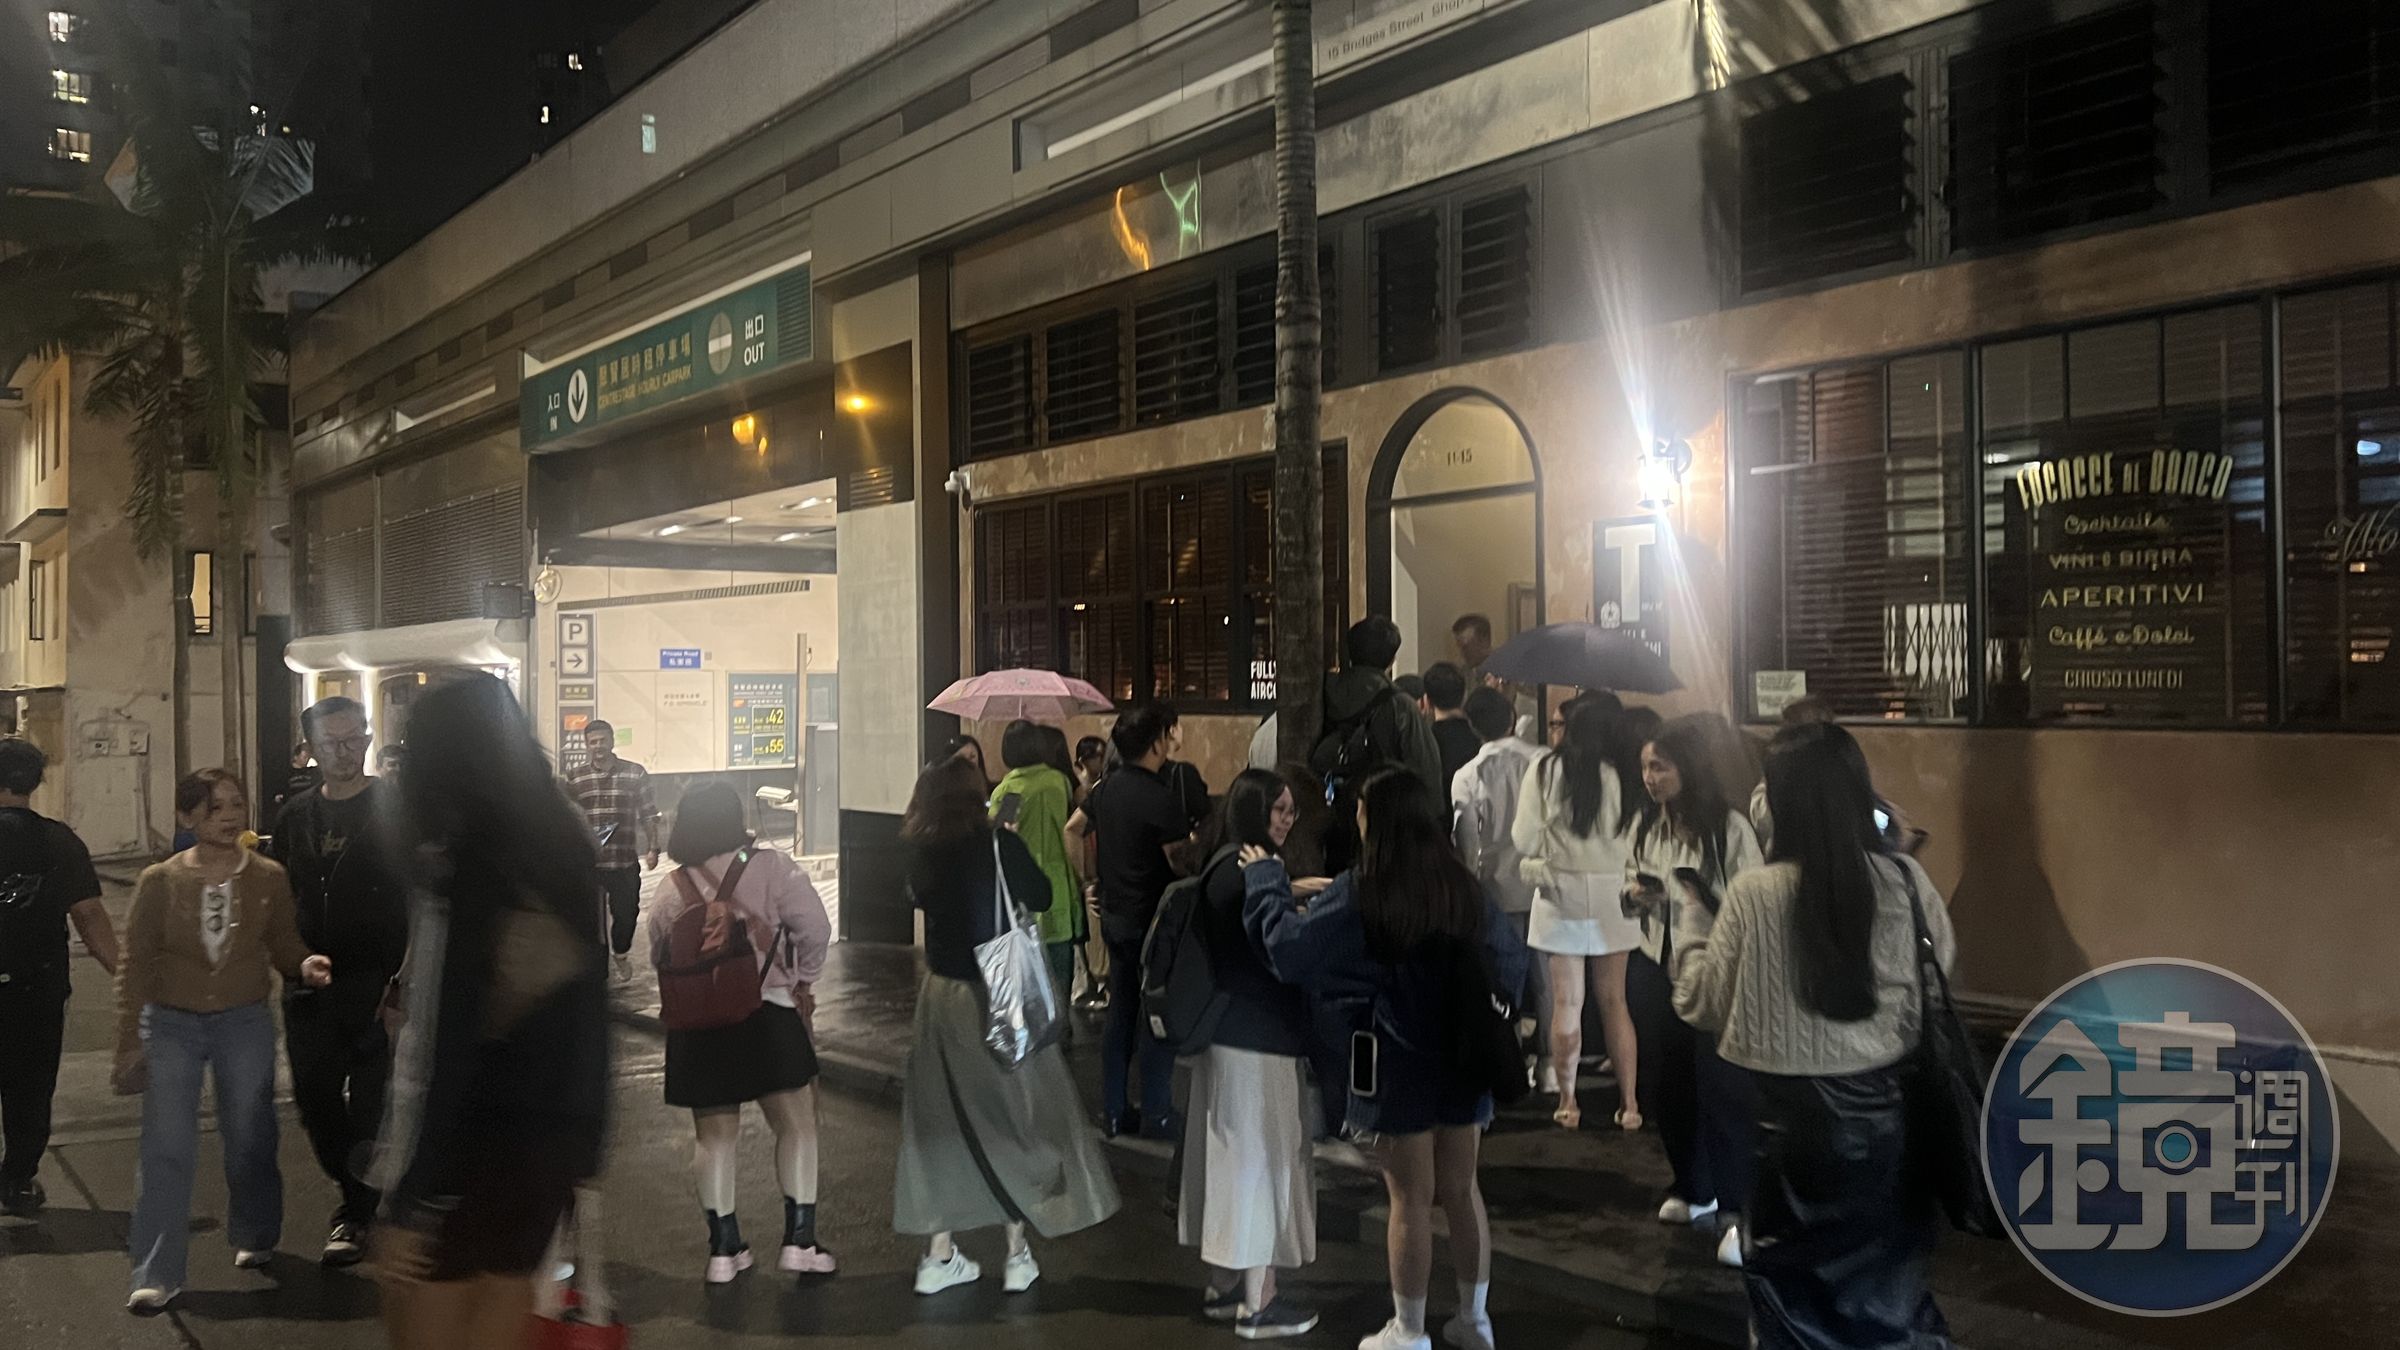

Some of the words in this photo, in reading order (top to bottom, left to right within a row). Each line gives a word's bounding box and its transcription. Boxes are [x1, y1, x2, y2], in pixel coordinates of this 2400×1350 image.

[1343, 28, 1386, 54] Bridges
[1389, 11, 1424, 35] Street
[745, 313, 764, 340] 出口
[744, 341, 765, 366] OUT
[662, 364, 691, 386] CARPARK
[547, 392, 560, 413] 入口
[550, 415, 558, 432] IN
[2016, 451, 2113, 511] FOCACCE
[2149, 448, 2234, 500] BANCO
[2048, 552, 2095, 570] VINI
[2119, 547, 2193, 569] BIRRA
[1605, 523, 1656, 623] T
[2040, 583, 2204, 608] APERITIVI
[568, 623, 583, 641] P
[2132, 624, 2195, 645] Dolci
